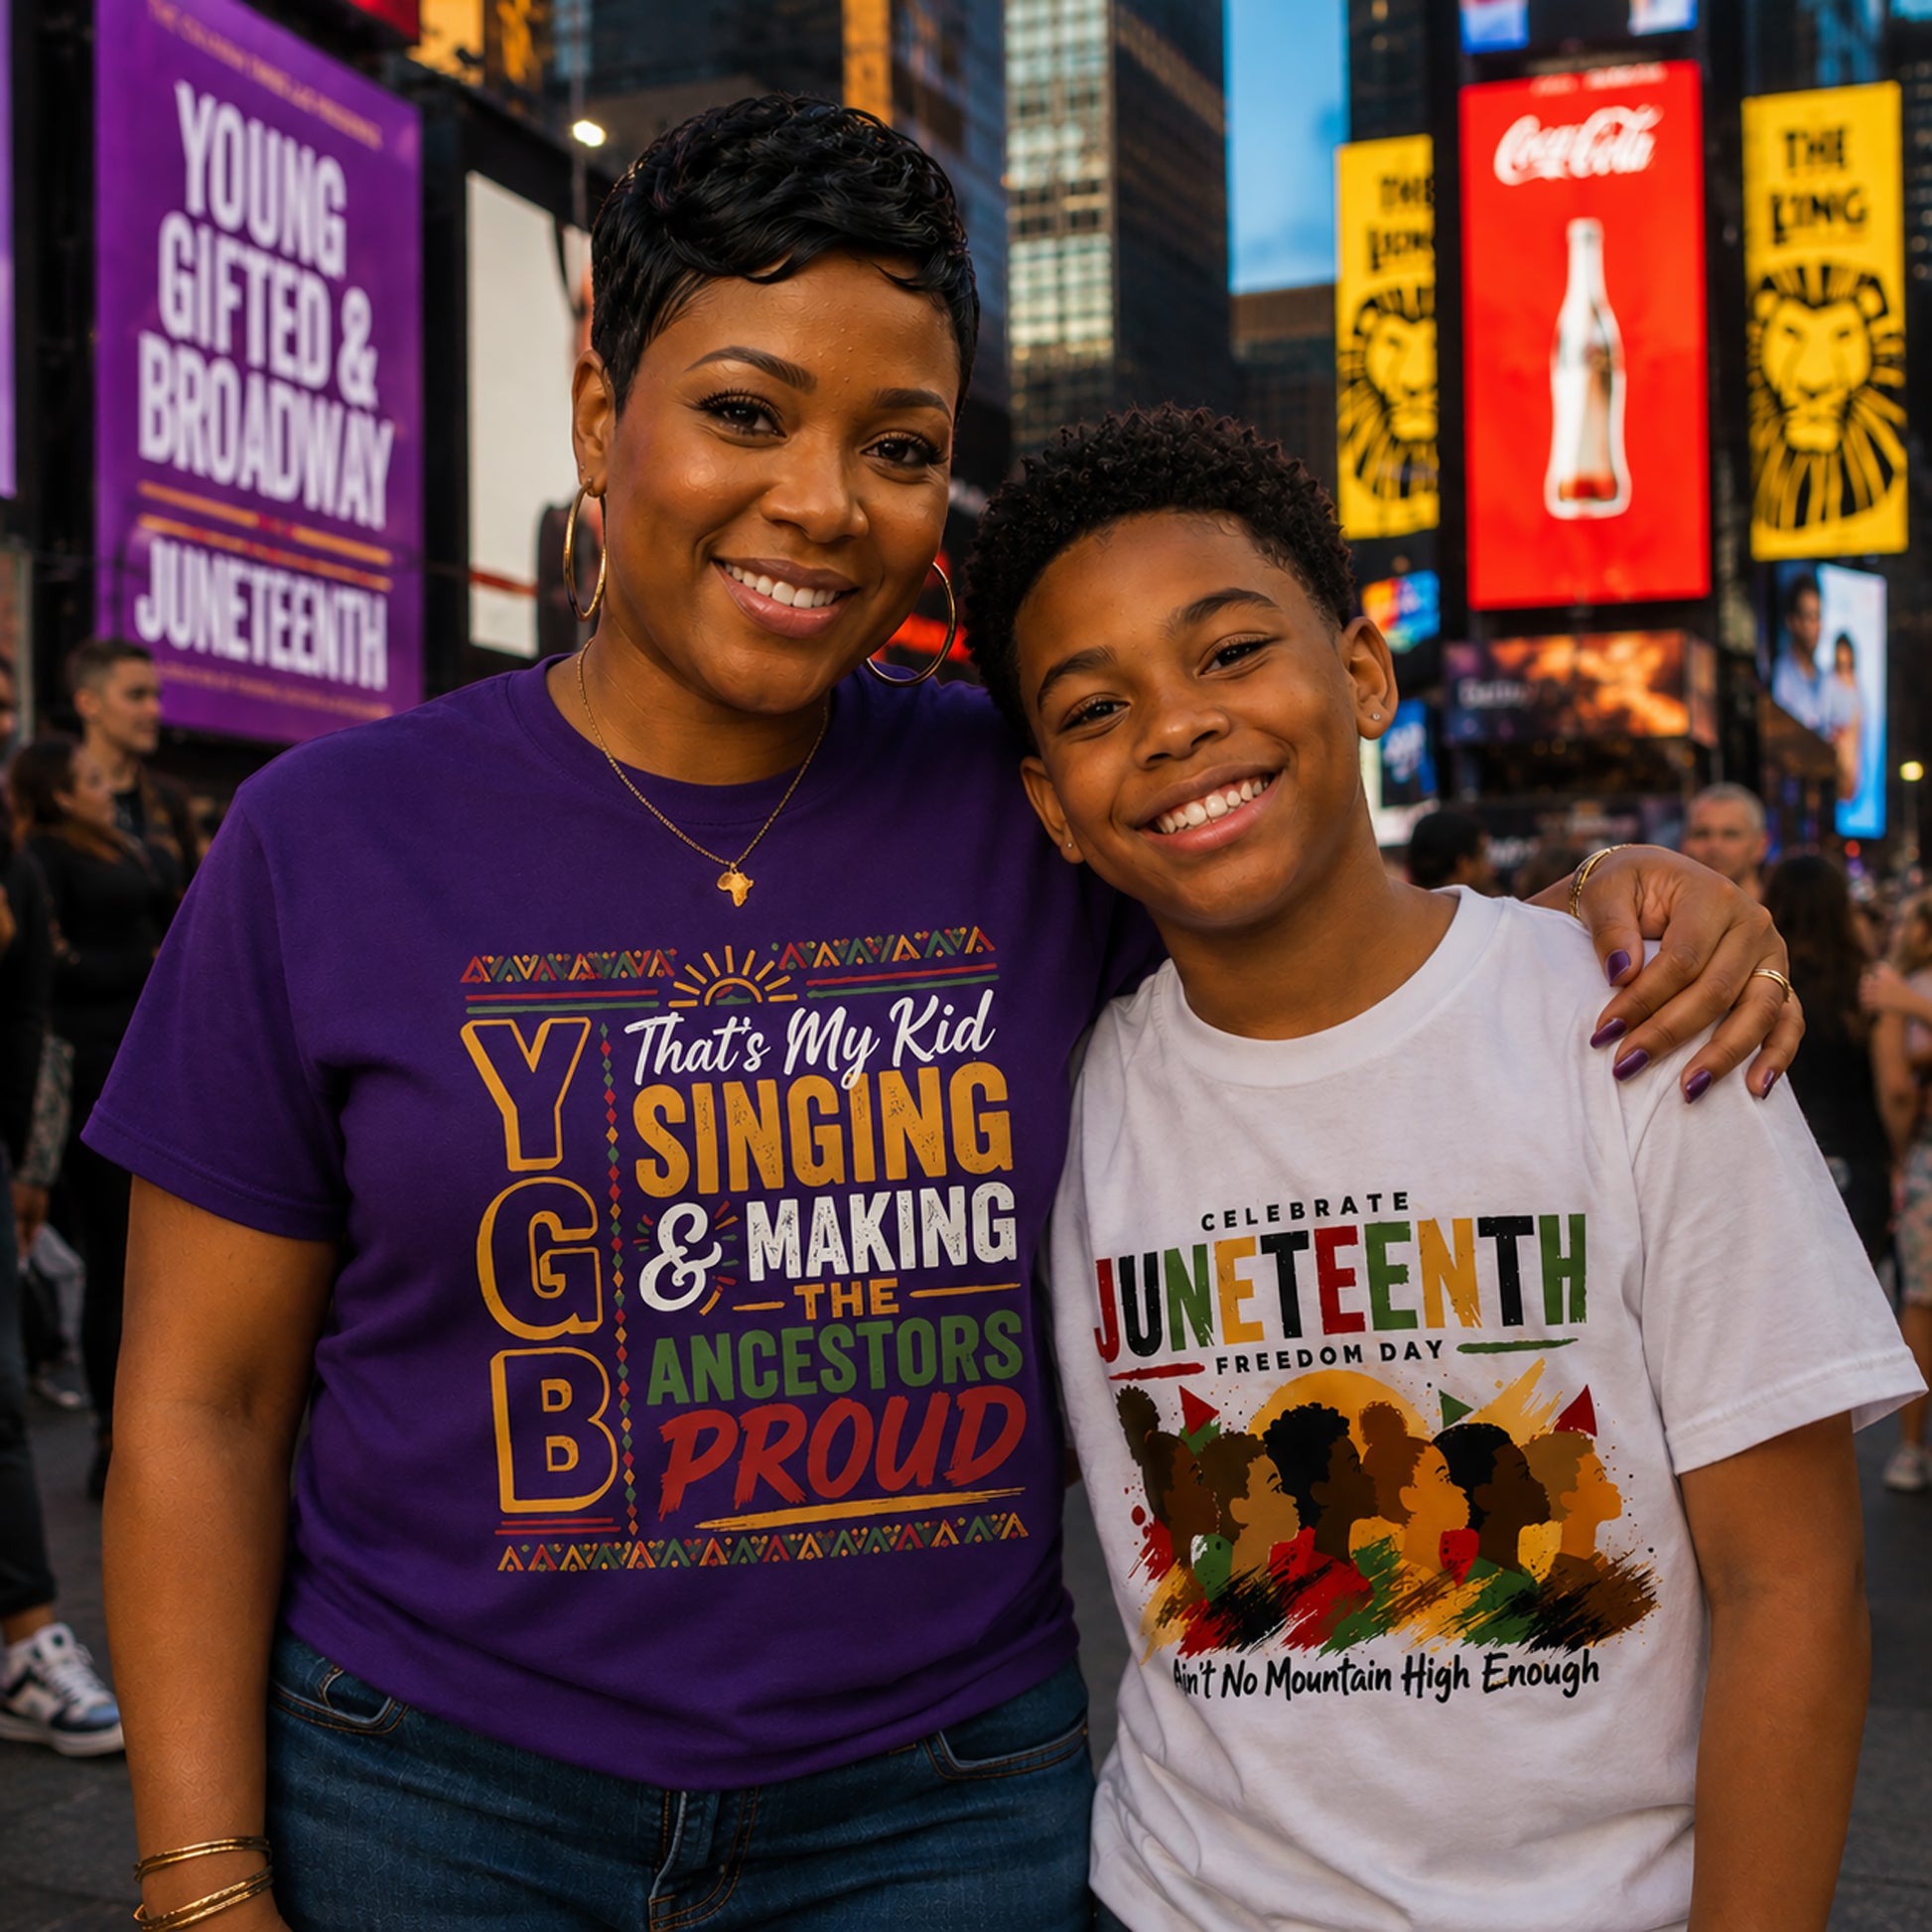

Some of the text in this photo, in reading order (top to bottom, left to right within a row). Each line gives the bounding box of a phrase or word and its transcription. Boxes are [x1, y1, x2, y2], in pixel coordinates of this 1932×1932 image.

[175, 79, 347, 282] YOUNG
[158, 209, 379, 409] GIFTED &
[138, 329, 394, 531] BROADWAY
[134, 536, 388, 692] JUNETEENTH
[623, 990, 996, 1089] That's My Kid
[633, 1062, 1013, 1198] SINGING
[638, 1185, 1016, 1312] & MAKING
[1201, 1191, 1410, 1232] CELEBRATE
[793, 1278, 900, 1320] THE
[1093, 1213, 1587, 1364] JUNETEENTH
[646, 1311, 1024, 1406] ANCESTORS
[1216, 1340, 1444, 1376] FREEDOM DAY
[659, 1386, 1027, 1517] PROUD
[1173, 1648, 1600, 1704] Ain't No Mountain High Enough
